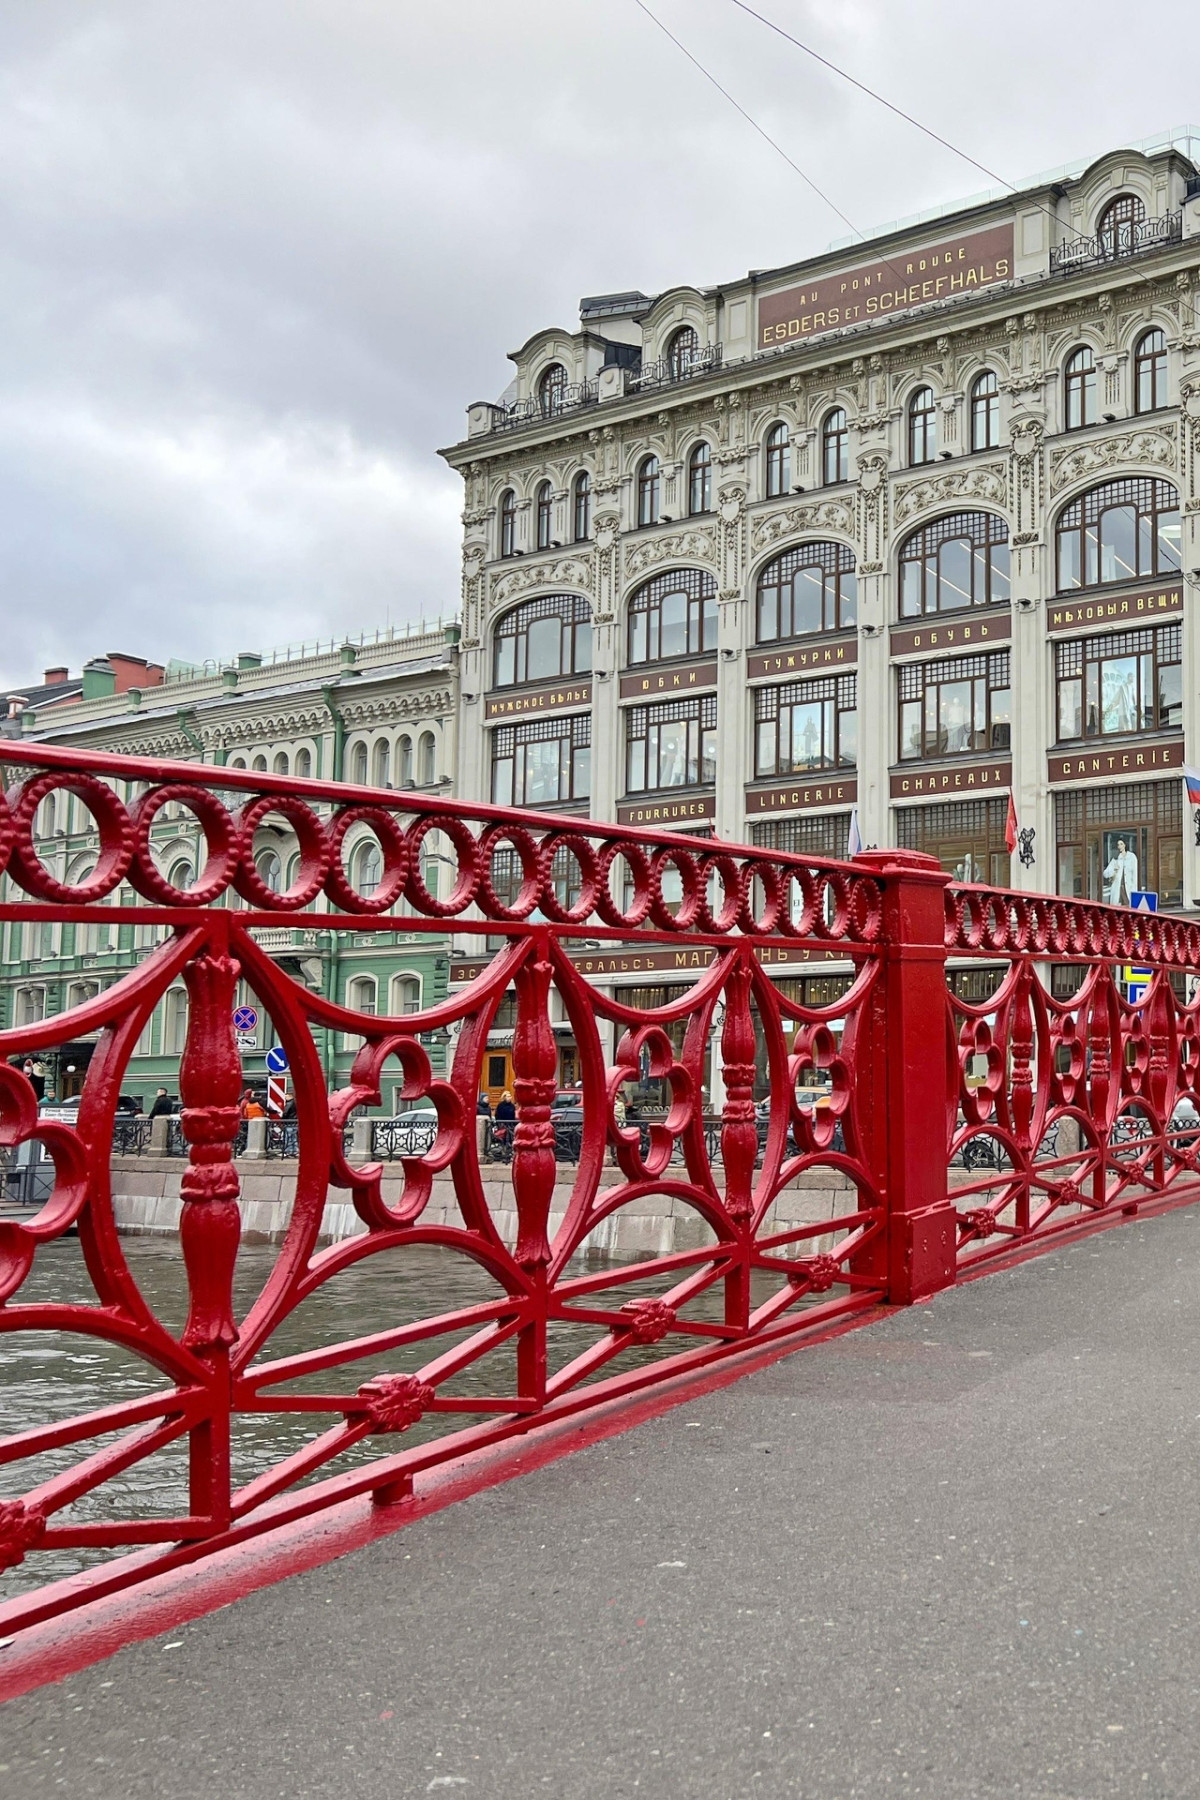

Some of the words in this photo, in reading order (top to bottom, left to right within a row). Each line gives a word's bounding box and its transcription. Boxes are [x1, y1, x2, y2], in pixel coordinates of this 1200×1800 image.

[799, 291, 818, 306] AU
[840, 273, 883, 295] PONT
[906, 247, 967, 275] ROUGE
[763, 308, 839, 344] ESDERS
[845, 305, 860, 320] ET
[865, 259, 1009, 315] SCHEEFHALS
[1137, 593, 1179, 610] ВЕЩИ
[914, 626, 989, 647] ОБУВЬ
[763, 648, 845, 670] ТУЖУРКИ
[642, 672, 697, 690] ЮБКИ
[491, 696, 544, 714] МУЖСКОЕ
[902, 770, 1002, 791] CHAPEAUX
[629, 803, 705, 822] FOURRURES
